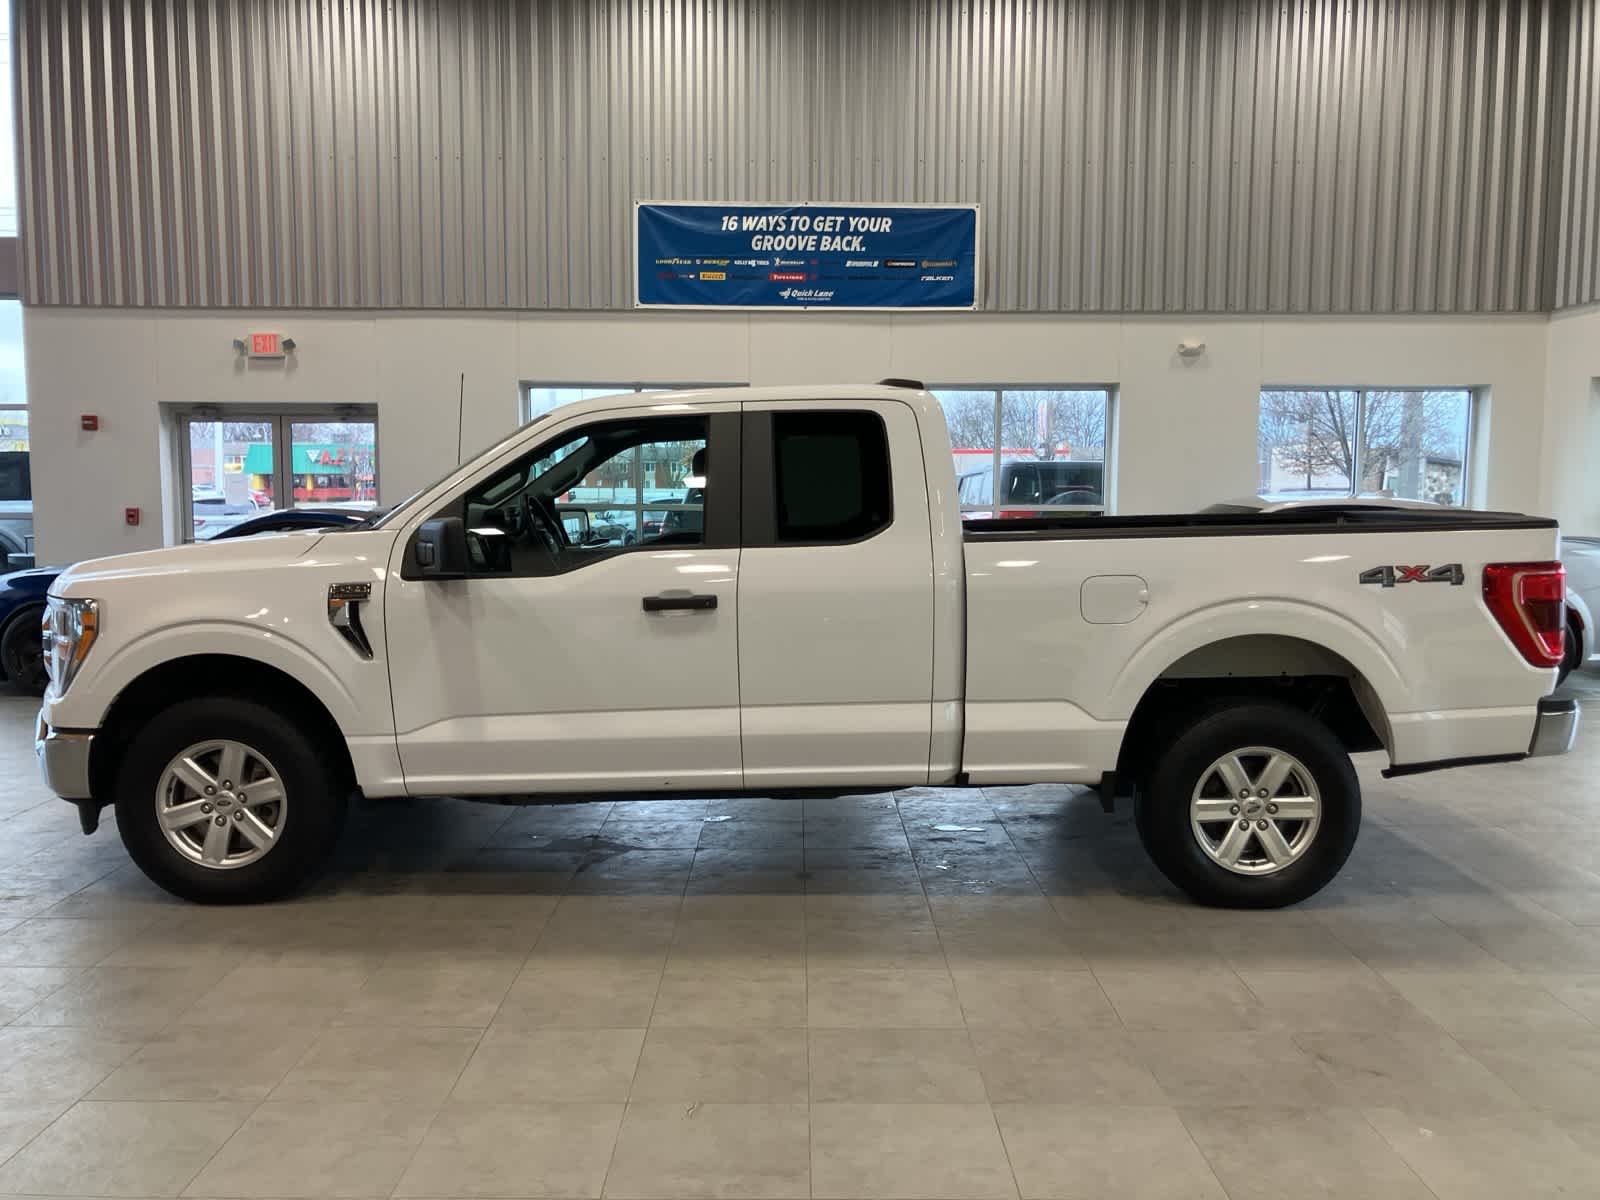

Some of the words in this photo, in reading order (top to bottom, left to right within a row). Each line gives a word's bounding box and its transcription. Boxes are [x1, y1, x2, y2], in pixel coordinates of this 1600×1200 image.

[721, 216, 738, 231] 16
[742, 216, 787, 231] WAYS
[790, 216, 810, 231] TO
[813, 216, 845, 232] GET
[848, 217, 892, 233] YOUR
[751, 235, 818, 251] GROOVE
[820, 236, 866, 252] BACK.
[791, 289, 813, 297] Quick
[252, 335, 278, 352] EXIT
